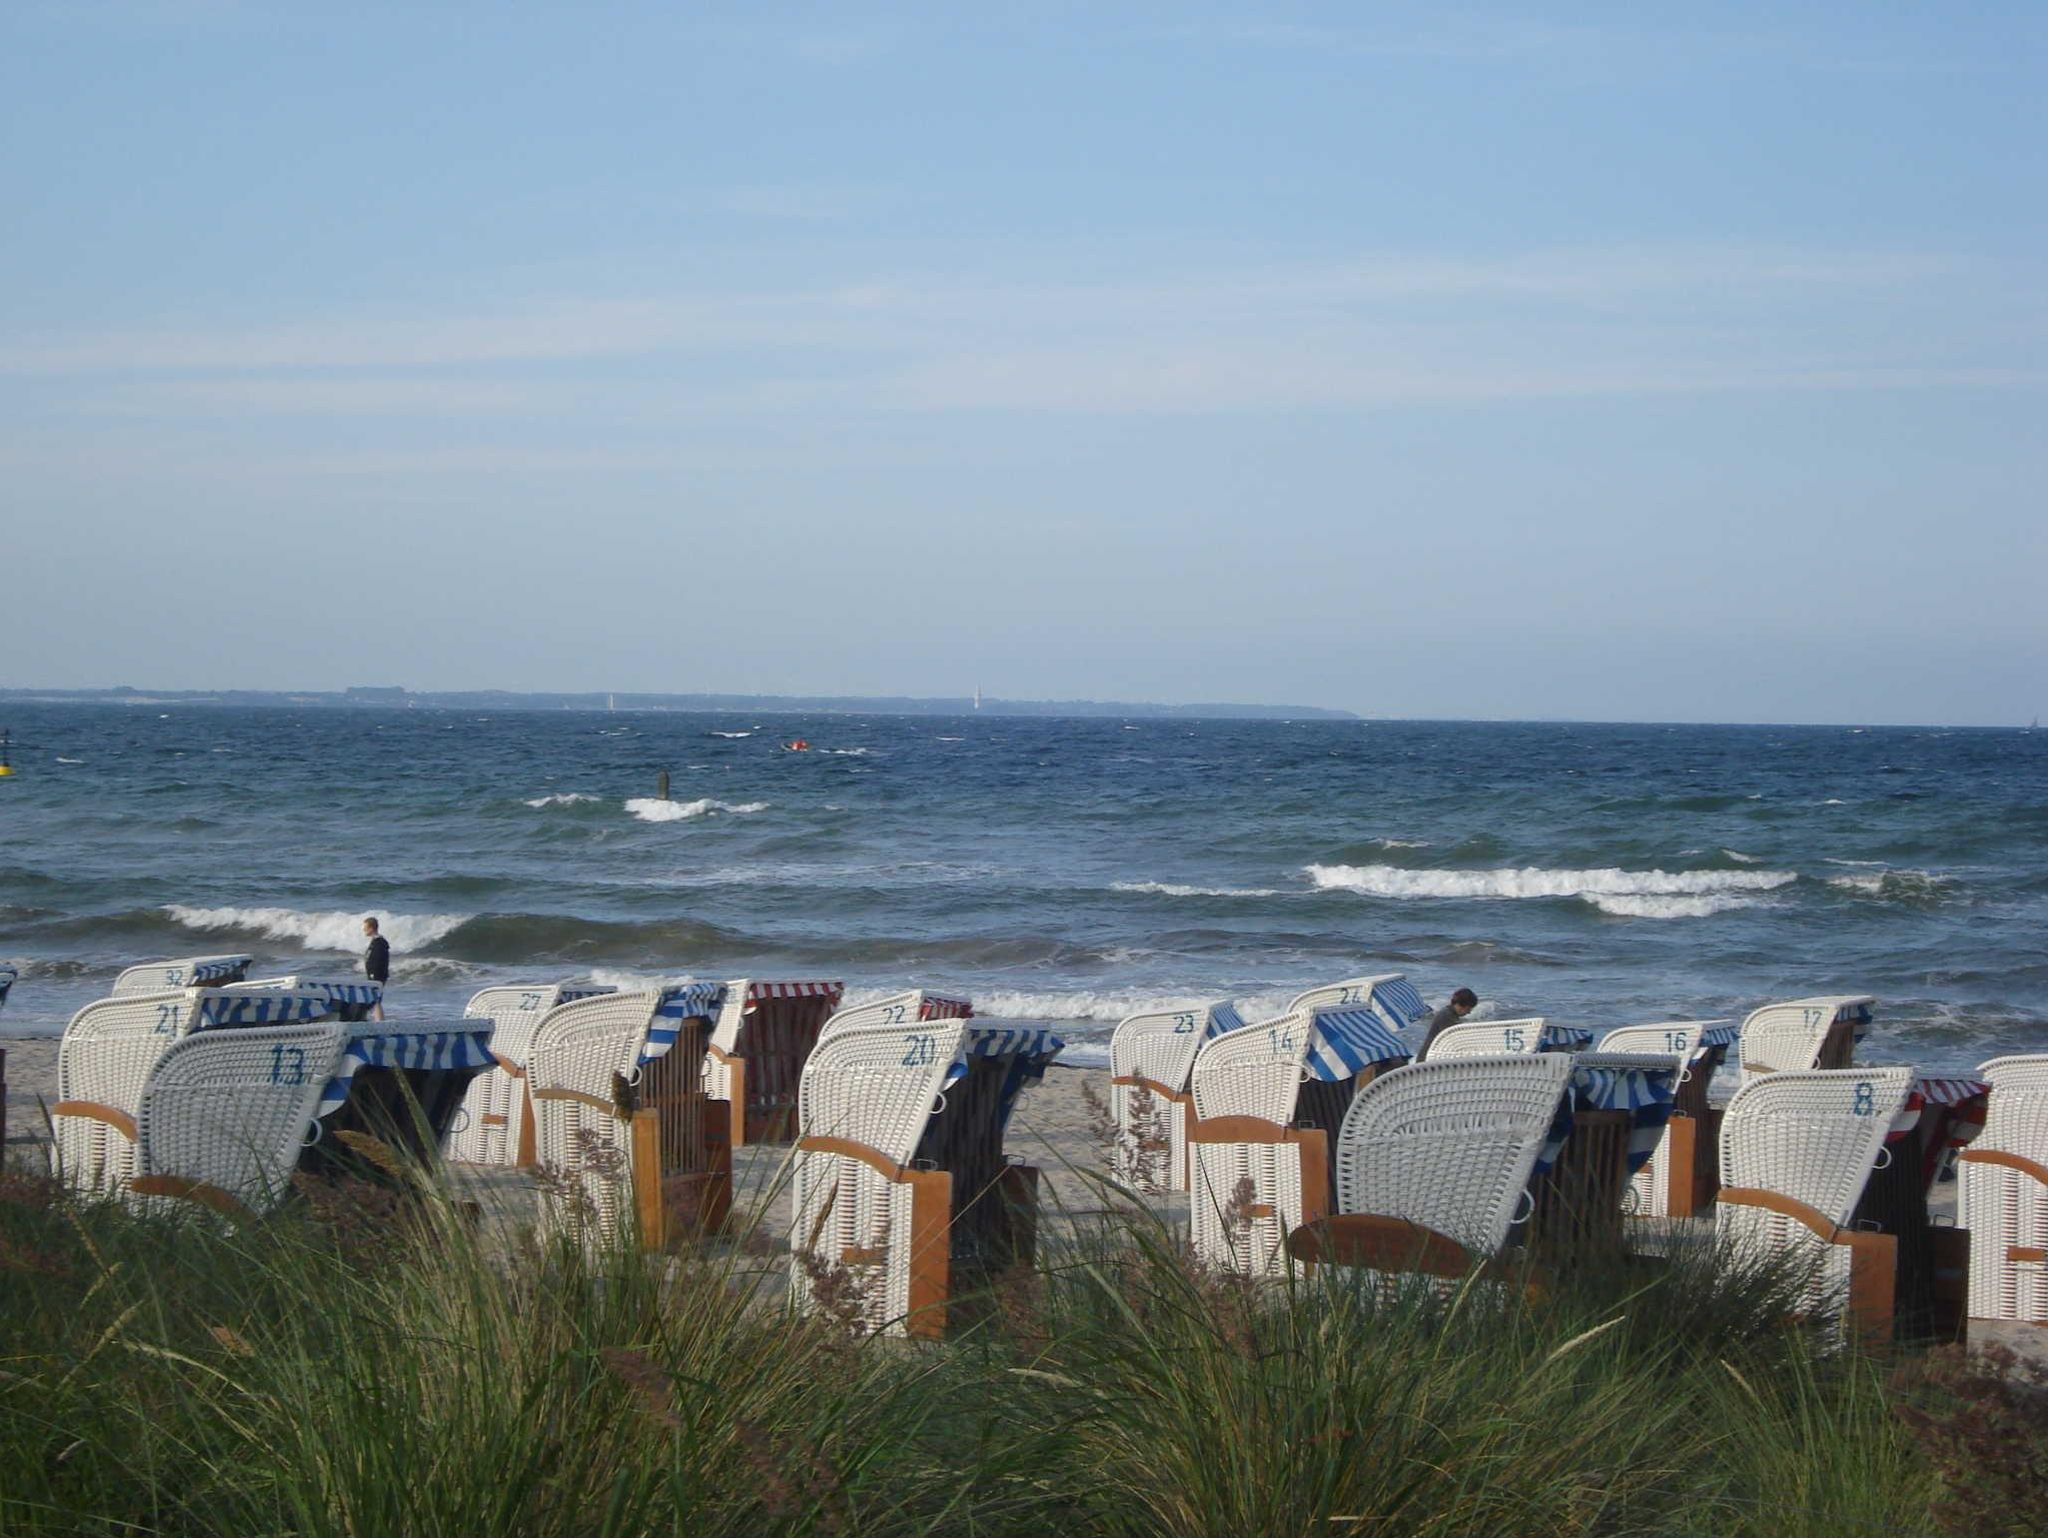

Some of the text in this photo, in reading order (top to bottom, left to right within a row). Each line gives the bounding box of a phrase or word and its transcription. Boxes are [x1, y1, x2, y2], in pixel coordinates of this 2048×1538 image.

[519, 993, 541, 1011] 27
[155, 1004, 178, 1036] 21
[882, 1005, 905, 1024] 22
[1174, 1015, 1194, 1034] 23
[1803, 1009, 1822, 1028] 17
[903, 1035, 936, 1066] 20
[1269, 1026, 1292, 1054] 14
[1505, 1028, 1524, 1051] 15
[1665, 1032, 1688, 1052] 16
[271, 1043, 304, 1084] 13
[1854, 1082, 1873, 1116] 8
